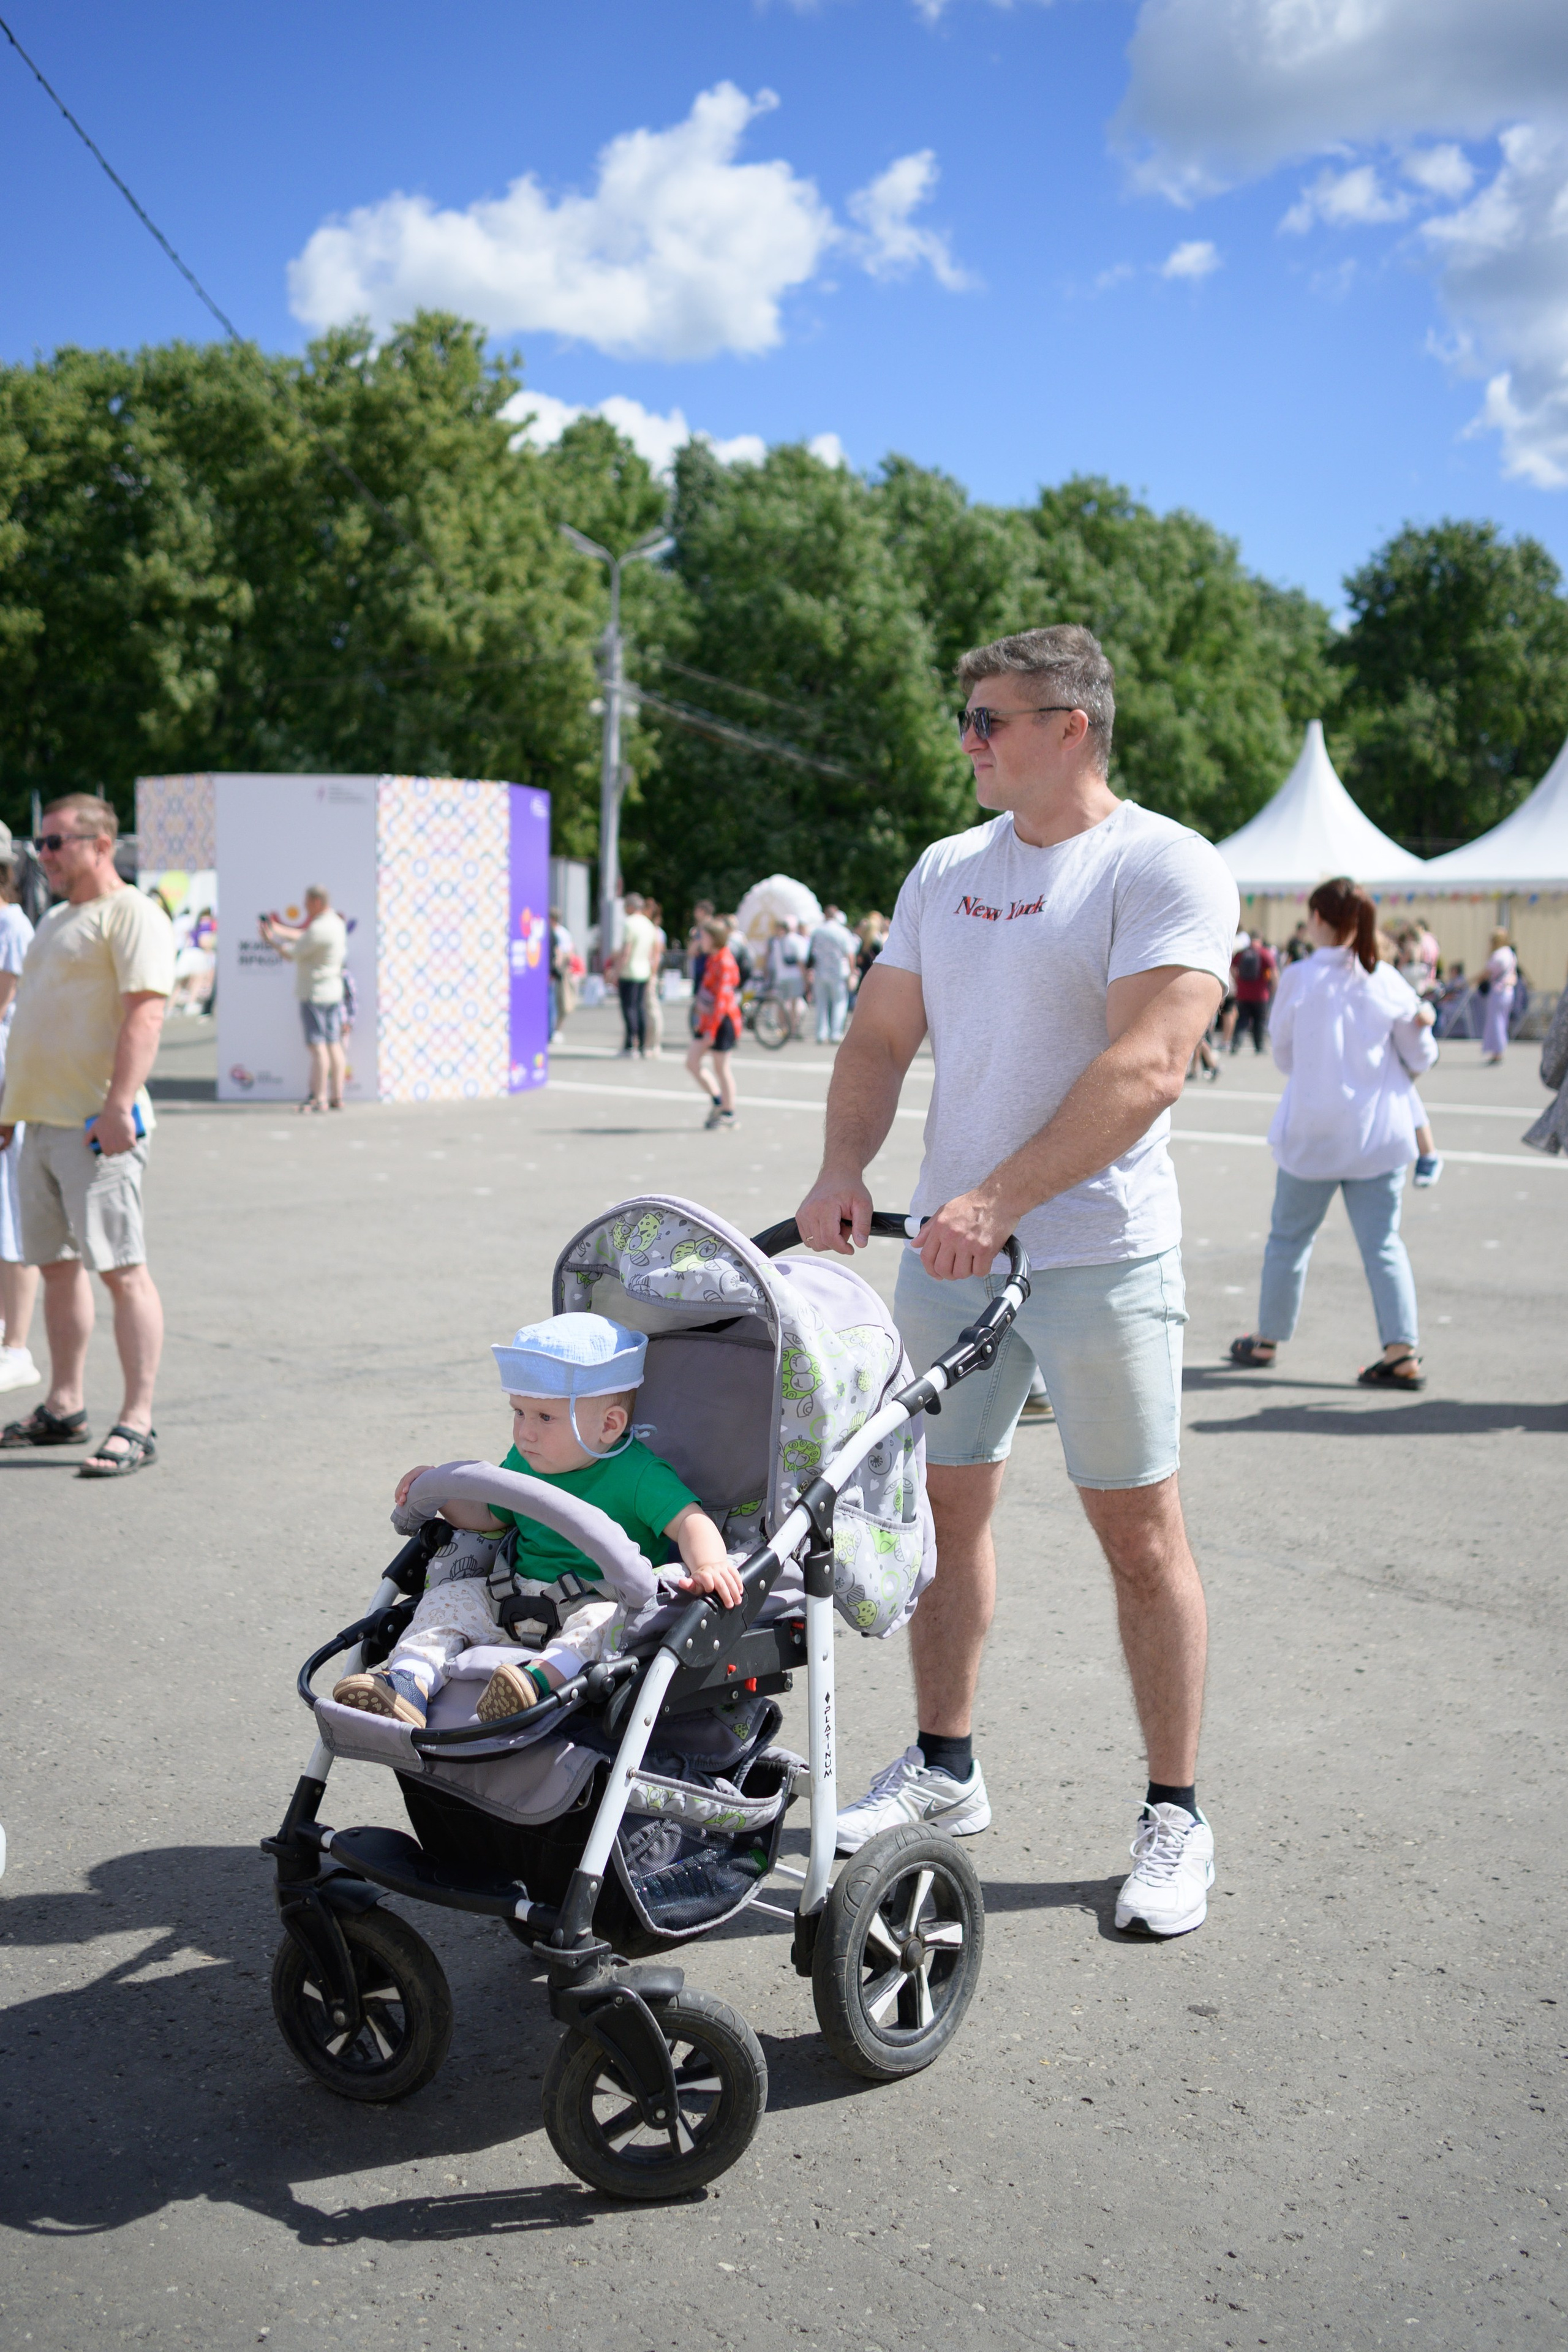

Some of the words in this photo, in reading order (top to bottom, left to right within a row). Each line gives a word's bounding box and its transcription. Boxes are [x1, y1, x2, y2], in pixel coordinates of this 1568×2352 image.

[953, 895, 1003, 921] New
[1005, 894, 1047, 921] York
[824, 1706, 832, 1779] PLATINUM
